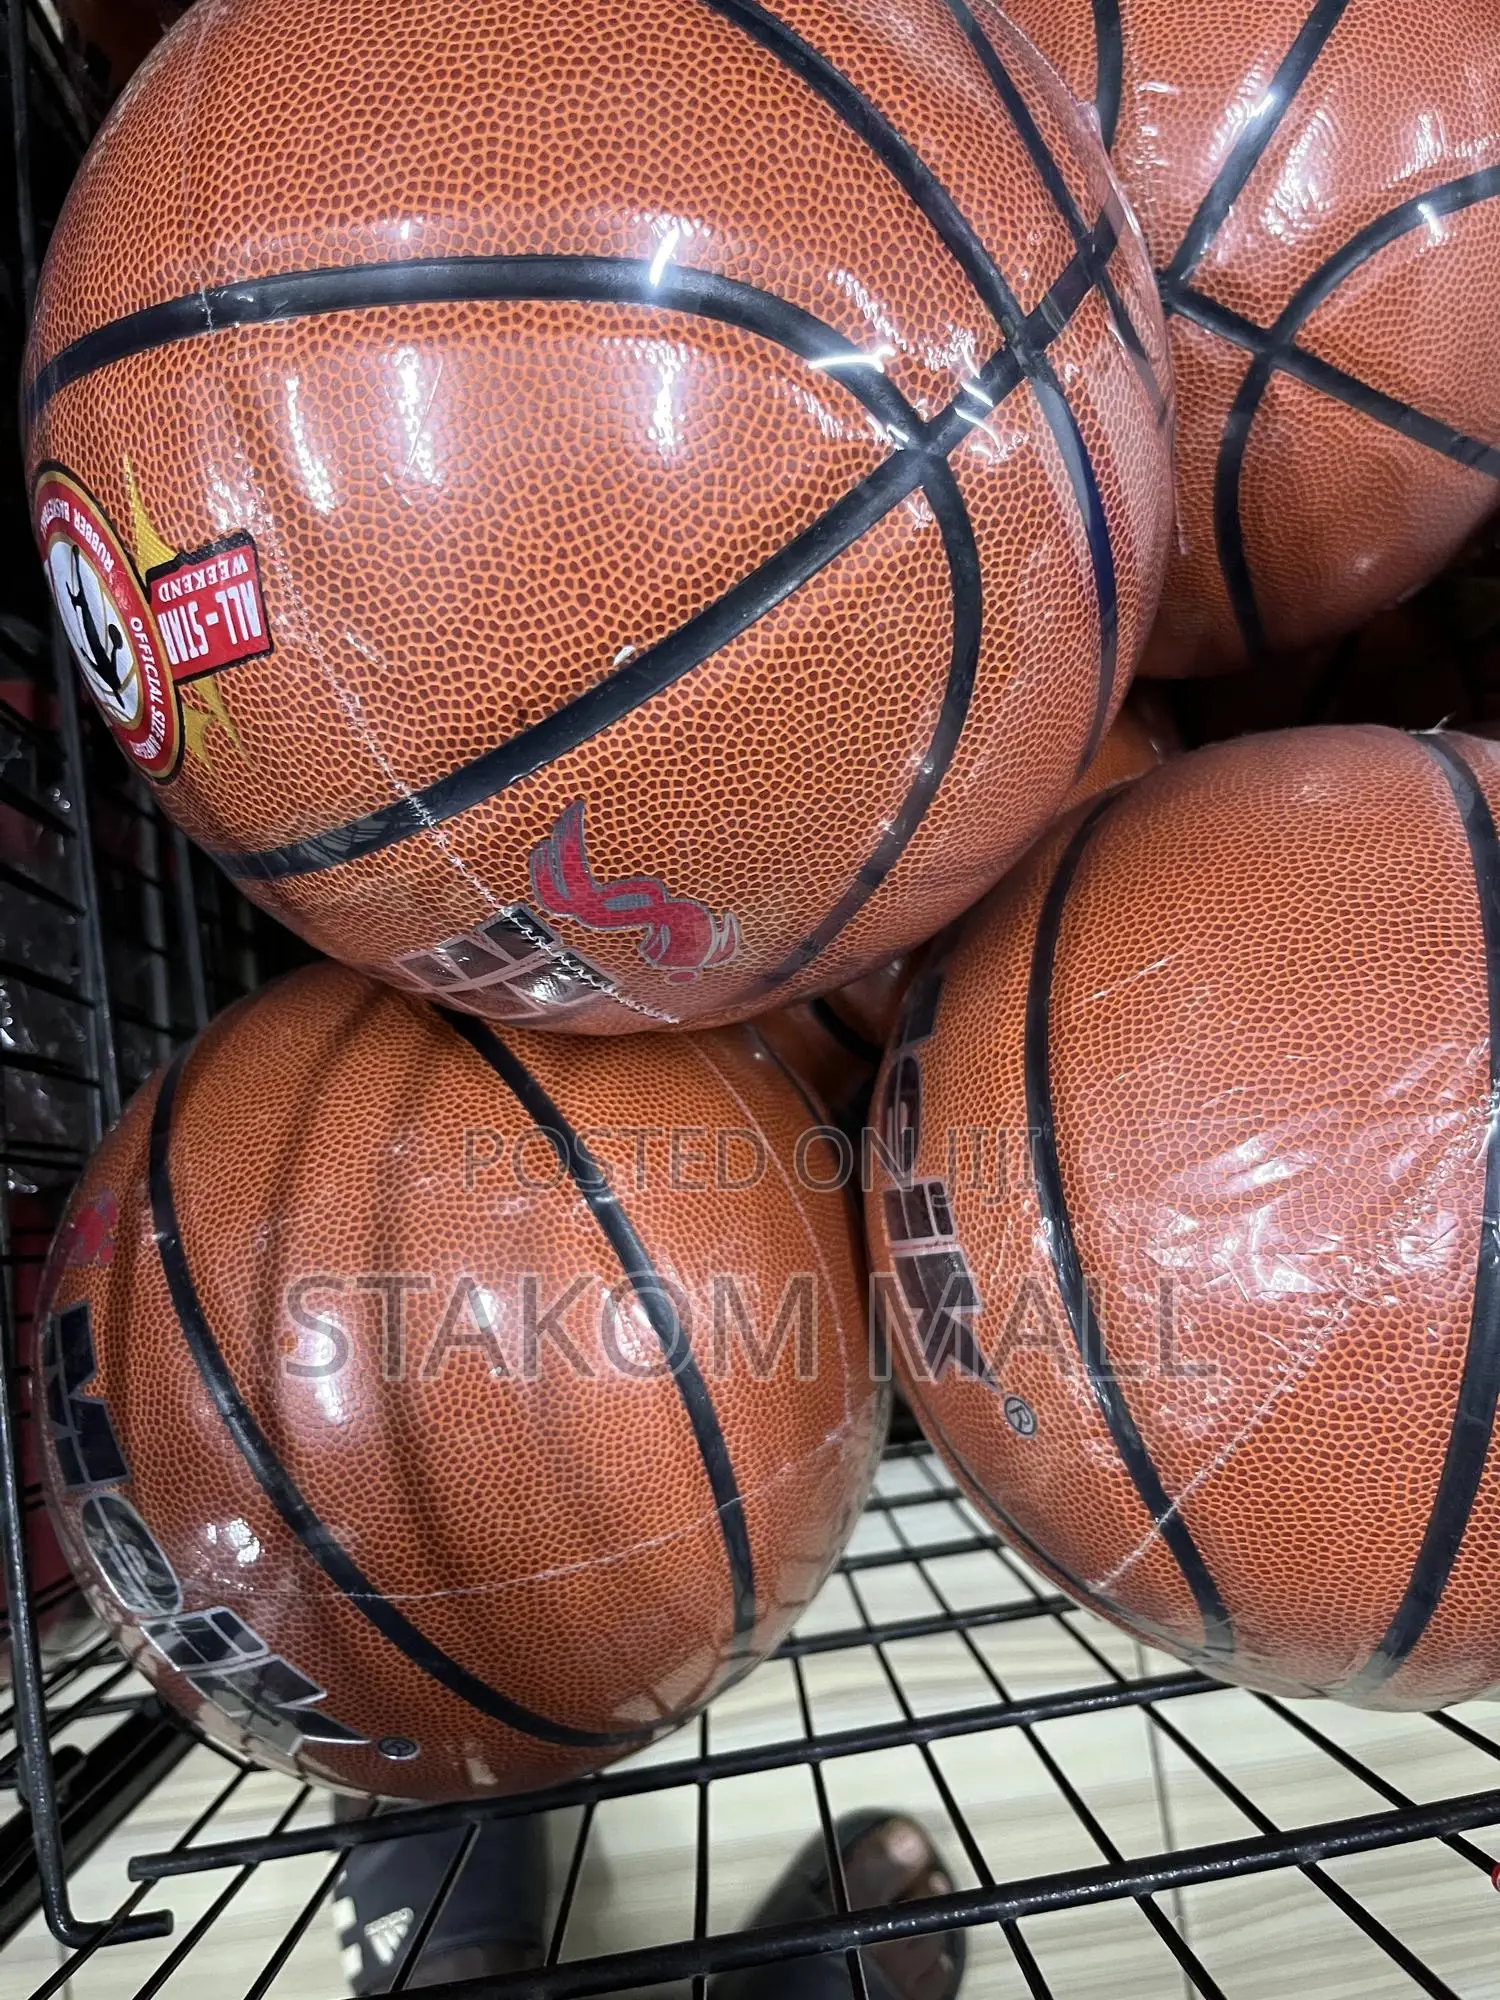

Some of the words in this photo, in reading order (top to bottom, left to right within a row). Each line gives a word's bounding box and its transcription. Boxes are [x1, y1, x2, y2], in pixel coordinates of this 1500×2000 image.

[73, 508, 115, 574] RUBBER
[158, 553, 249, 603] WEEKEND
[130, 617, 164, 705] OFFICIAL
[151, 705, 165, 743] SIZE
